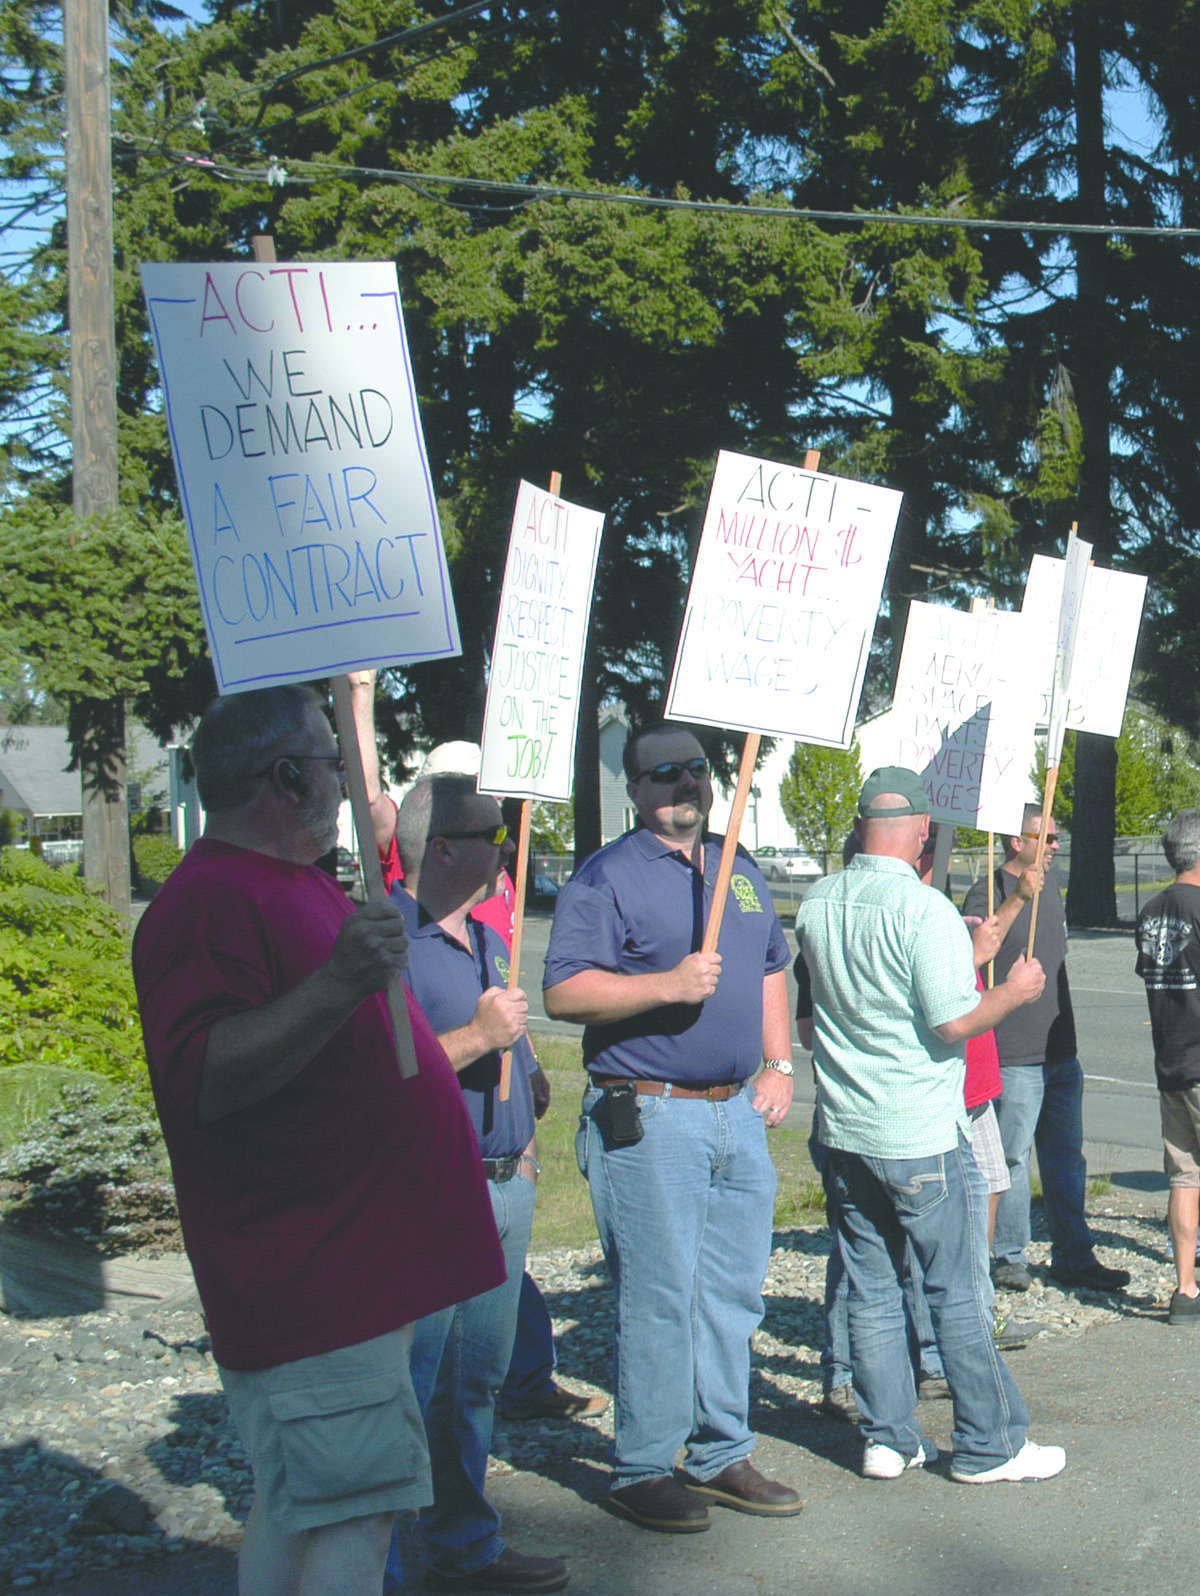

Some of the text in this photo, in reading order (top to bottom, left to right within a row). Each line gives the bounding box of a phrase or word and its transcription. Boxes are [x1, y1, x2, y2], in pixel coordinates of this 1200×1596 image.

[200, 269, 377, 337] ACTI...
[223, 349, 323, 400] WE
[200, 389, 393, 460] DEMAND
[213, 467, 387, 545] A FAIR
[737, 463, 838, 523] ACTI
[523, 491, 570, 555] ACTI
[716, 506, 820, 562] MILLION
[212, 533, 428, 626] CONTRACT
[702, 592, 851, 652] POVERTY
[498, 643, 572, 700] JUSTICE
[704, 650, 818, 696] WAGES
[499, 695, 559, 736] ON THE
[506, 733, 554, 779] JOB!
[898, 739, 1014, 786] POVERTY
[922, 779, 982, 814] AGES
